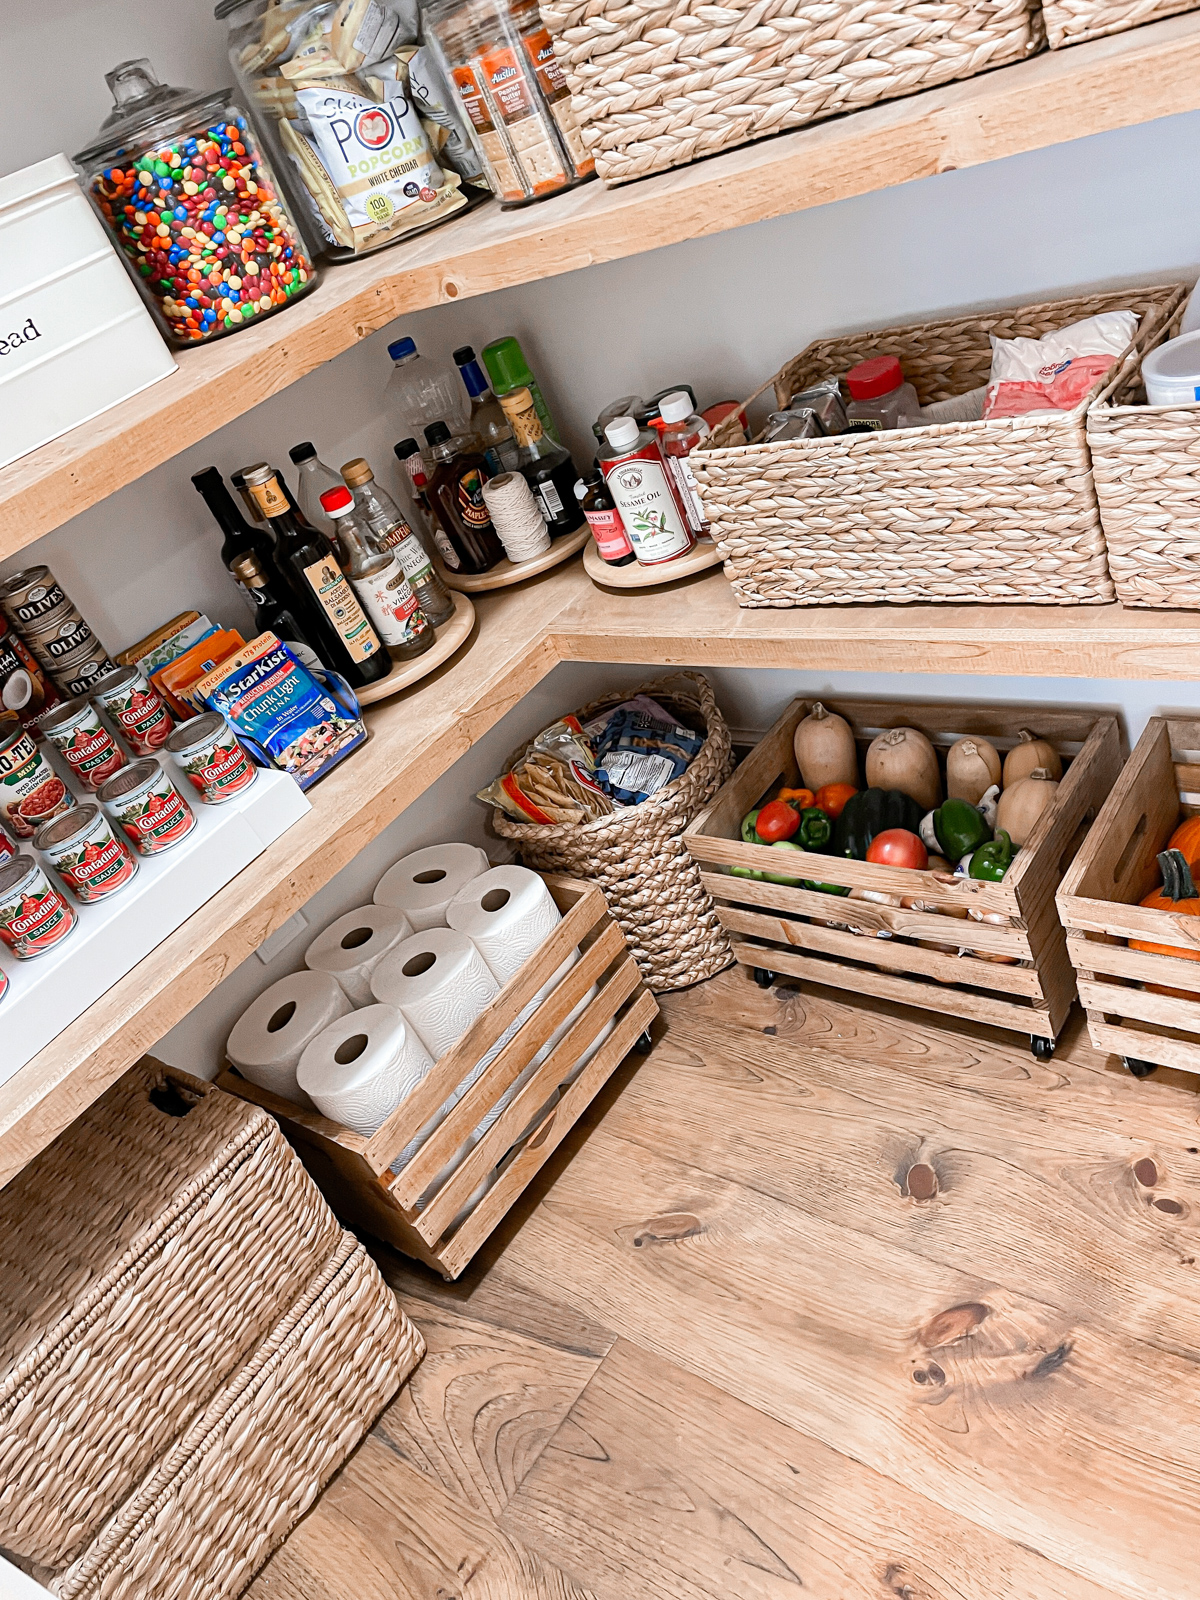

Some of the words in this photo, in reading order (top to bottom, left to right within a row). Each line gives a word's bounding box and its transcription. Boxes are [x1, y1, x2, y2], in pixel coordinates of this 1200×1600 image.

[537, 46, 553, 61] Aus
[497, 83, 520, 97] Peanut
[501, 90, 521, 102] Butter
[329, 95, 410, 163] POP
[347, 136, 424, 178] POPCORN
[368, 172, 389, 187] WHITE
[389, 159, 419, 179] CHEDDAR
[370, 197, 386, 212] 100
[619, 498, 646, 508] SESAME
[646, 490, 661, 501] OIL
[465, 507, 487, 519] MAPLE
[396, 582, 410, 596] RICE
[18, 586, 64, 620] OLIVES
[50, 621, 91, 656] OLIVES
[202, 680, 212, 691] 70
[210, 665, 233, 684] Calories
[243, 649, 255, 660] 17g
[253, 634, 272, 652] Protein
[70, 660, 115, 694] OLIVES
[228, 649, 288, 699] StarKist
[263, 670, 285, 689] SODIUM
[243, 692, 278, 722] Chunk
[276, 675, 300, 701] Light
[265, 696, 291, 716] TUNA
[22, 706, 50, 729] oconut
[141, 711, 163, 730] PASTE
[281, 705, 298, 718] Water
[66, 733, 109, 762] Contadina
[17, 762, 37, 779] Mild
[85, 751, 110, 769] PASTE
[204, 748, 243, 780] Contadina
[221, 765, 244, 784] SAUCE
[139, 796, 180, 830] Contadina
[158, 813, 182, 834] SAUCE
[74, 844, 119, 879] Contadina
[94, 862, 120, 883] SAUCE
[12, 895, 58, 933] Contadina
[33, 914, 60, 937] SAUCE
